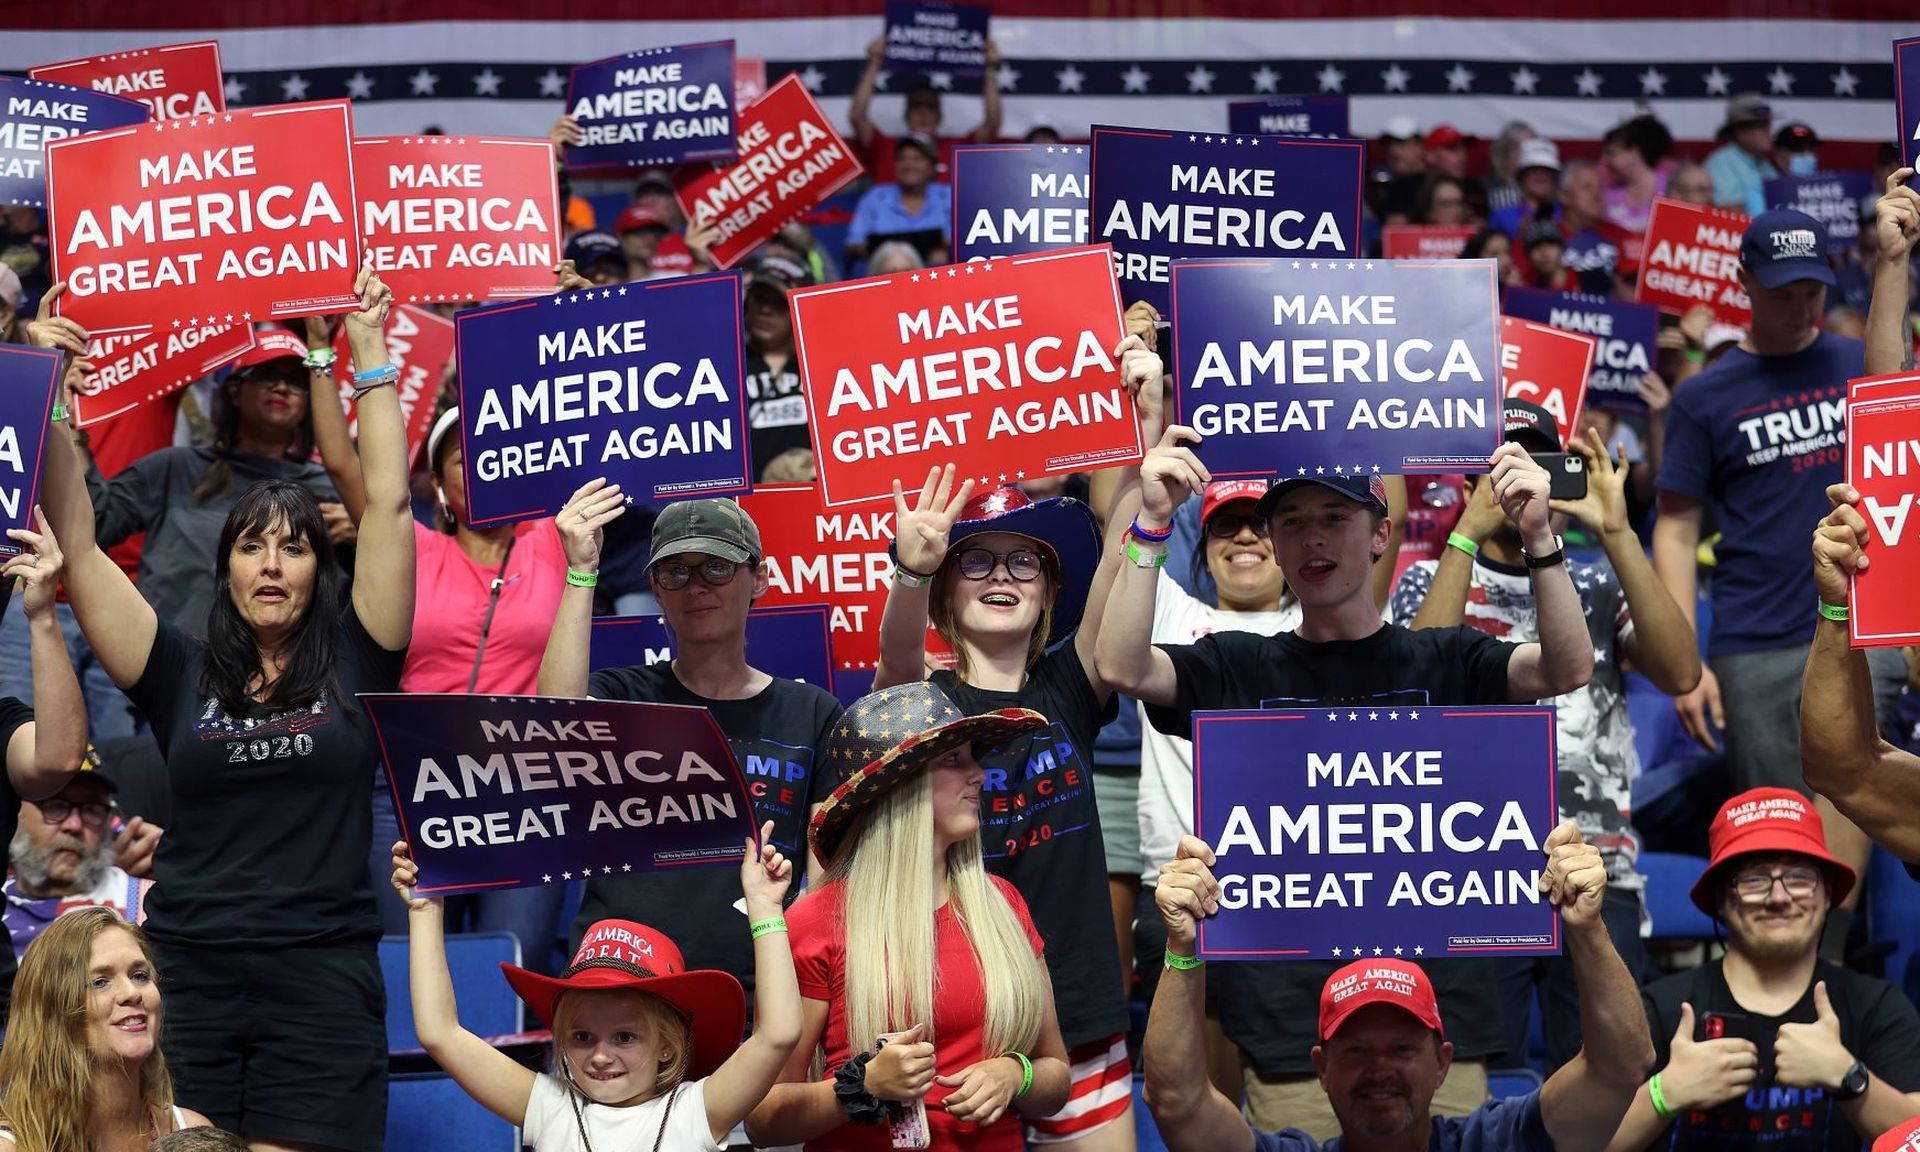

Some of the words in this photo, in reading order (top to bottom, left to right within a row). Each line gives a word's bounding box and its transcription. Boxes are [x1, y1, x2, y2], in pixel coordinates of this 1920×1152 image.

[889, 24, 984, 49] AMERICA
[91, 69, 167, 95] MAKE
[614, 63, 682, 87] MAKE
[8, 97, 89, 123] MAKE
[572, 83, 728, 120] AMERICA
[652, 116, 730, 141] AGAIN
[737, 120, 771, 156] KE
[1259, 114, 1311, 133] MAKE
[139, 144, 257, 189] MAKE
[388, 163, 484, 190] MAKE
[693, 120, 828, 228] AMERICA
[775, 142, 844, 200] AGAIN
[1171, 164, 1276, 197] MAKE
[1031, 173, 1089, 198] MA
[66, 180, 344, 255] AMERICA
[364, 197, 549, 236] MERICA
[965, 208, 1089, 246] AMER
[1102, 199, 1347, 252] AMERICA
[1695, 223, 1743, 252] MAK
[68, 252, 203, 297] GREAT
[216, 237, 348, 282] AGAIN
[364, 244, 438, 272] REAT
[446, 242, 551, 268] AGAIN
[1112, 251, 1170, 284] GRE
[1648, 239, 1741, 284] AMER
[1645, 268, 1719, 302] GREAT
[898, 295, 1023, 345] MAKE
[1273, 294, 1398, 326] MAKE
[1549, 307, 1614, 336] MAKE
[538, 319, 647, 366] MAKE
[84, 341, 159, 397] GREAT
[165, 324, 232, 360] AGA
[827, 329, 1117, 417] AMERICA
[1190, 338, 1485, 389] AMERICA
[474, 357, 730, 436] AMERICA
[832, 411, 972, 463] GREAT
[987, 388, 1124, 440] AGAIN
[1192, 399, 1335, 437] GREAT
[1347, 398, 1486, 431] AGAIN
[1503, 408, 1538, 424] rump
[1738, 397, 1847, 451] TRUM
[476, 432, 590, 482] GREAT
[600, 418, 733, 463] AGAIN
[1746, 446, 1780, 467] KEEP
[1781, 432, 1837, 457] AMERICA
[1248, 484, 1267, 494] AGA
[815, 512, 898, 543] MAK
[764, 552, 897, 595] AMER
[227, 733, 313, 763] 2020
[480, 718, 617, 743] MAKE
[412, 750, 726, 803] AMERICA
[1307, 750, 1444, 787] MAKE
[992, 769, 1080, 813] ENCE
[419, 804, 570, 849] GREAT
[588, 792, 738, 832] AGAIN
[1726, 801, 1757, 821] MAKE
[1758, 798, 1806, 814] AMERICA
[1734, 809, 1767, 827] GREAT
[1768, 809, 1801, 822] AGAIN
[1005, 824, 1052, 857] 2020
[1214, 800, 1539, 856] AMERICA
[1218, 872, 1373, 910] GREAT
[1387, 869, 1541, 907] AGAIN
[592, 926, 654, 958] AMERICA
[1329, 974, 1358, 994] MAKE
[1363, 968, 1417, 987] AMERICA
[1333, 981, 1368, 1003] GREAT
[1374, 980, 1413, 997] AGAIN
[1745, 1087, 1824, 1110] UMP
